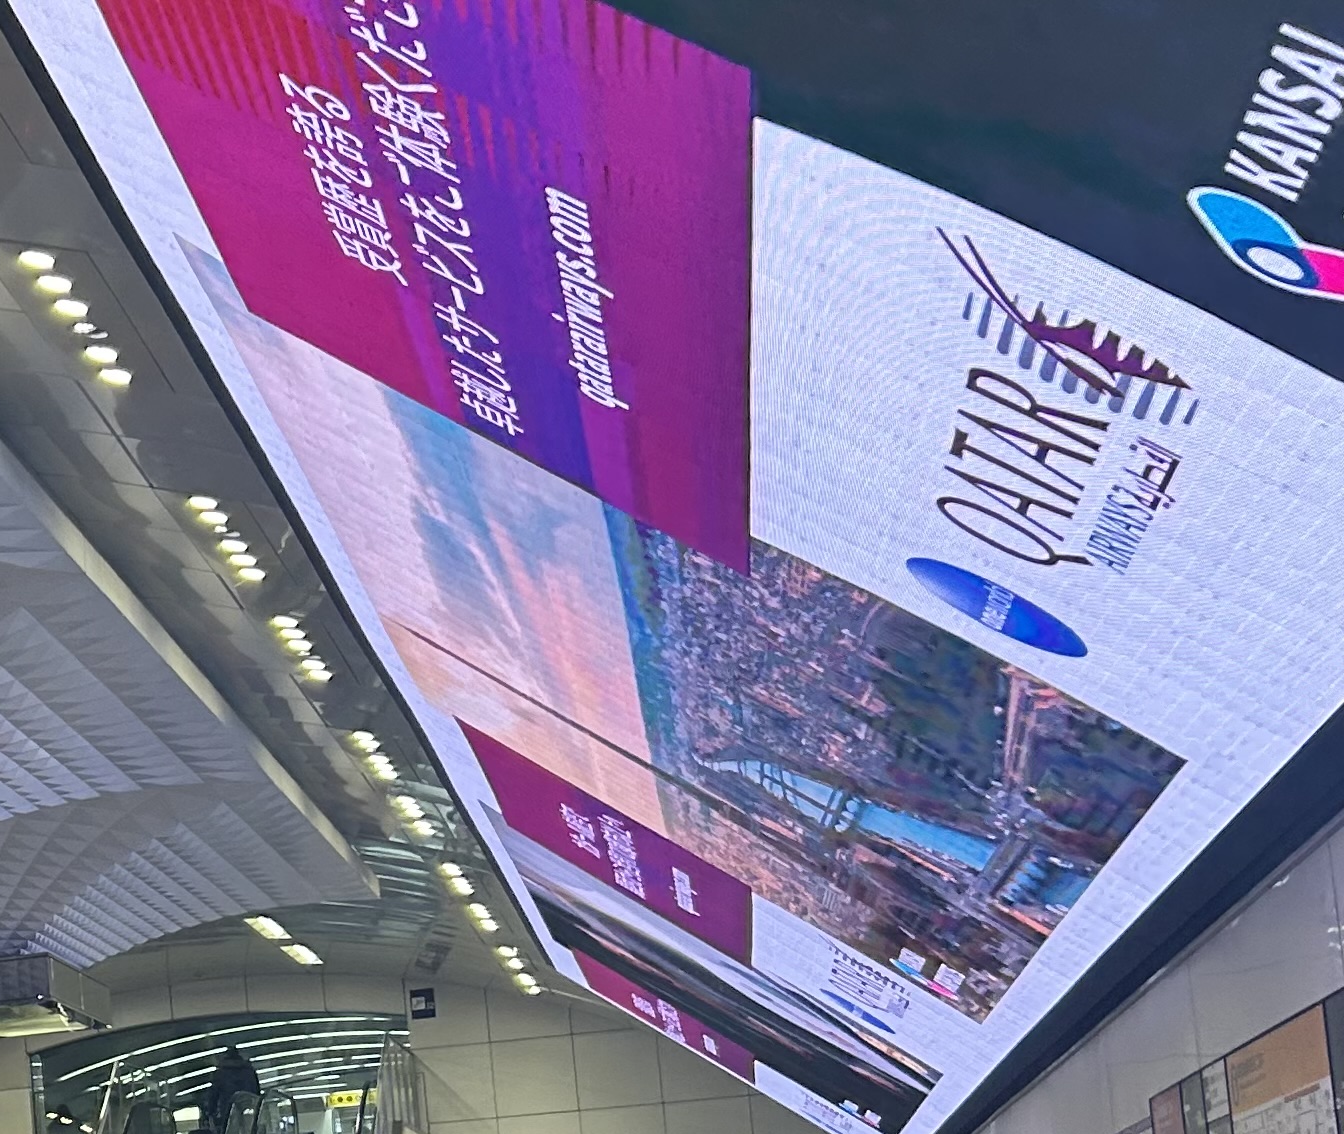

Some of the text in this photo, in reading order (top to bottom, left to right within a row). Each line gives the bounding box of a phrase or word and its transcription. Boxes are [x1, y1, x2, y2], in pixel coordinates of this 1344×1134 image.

[279, 73, 408, 286] 受賞歴を誇る
[1224, 23, 1344, 201] KANSAI
[545, 186, 629, 410] qatarairways.com
[937, 367, 1111, 566] QATAR
